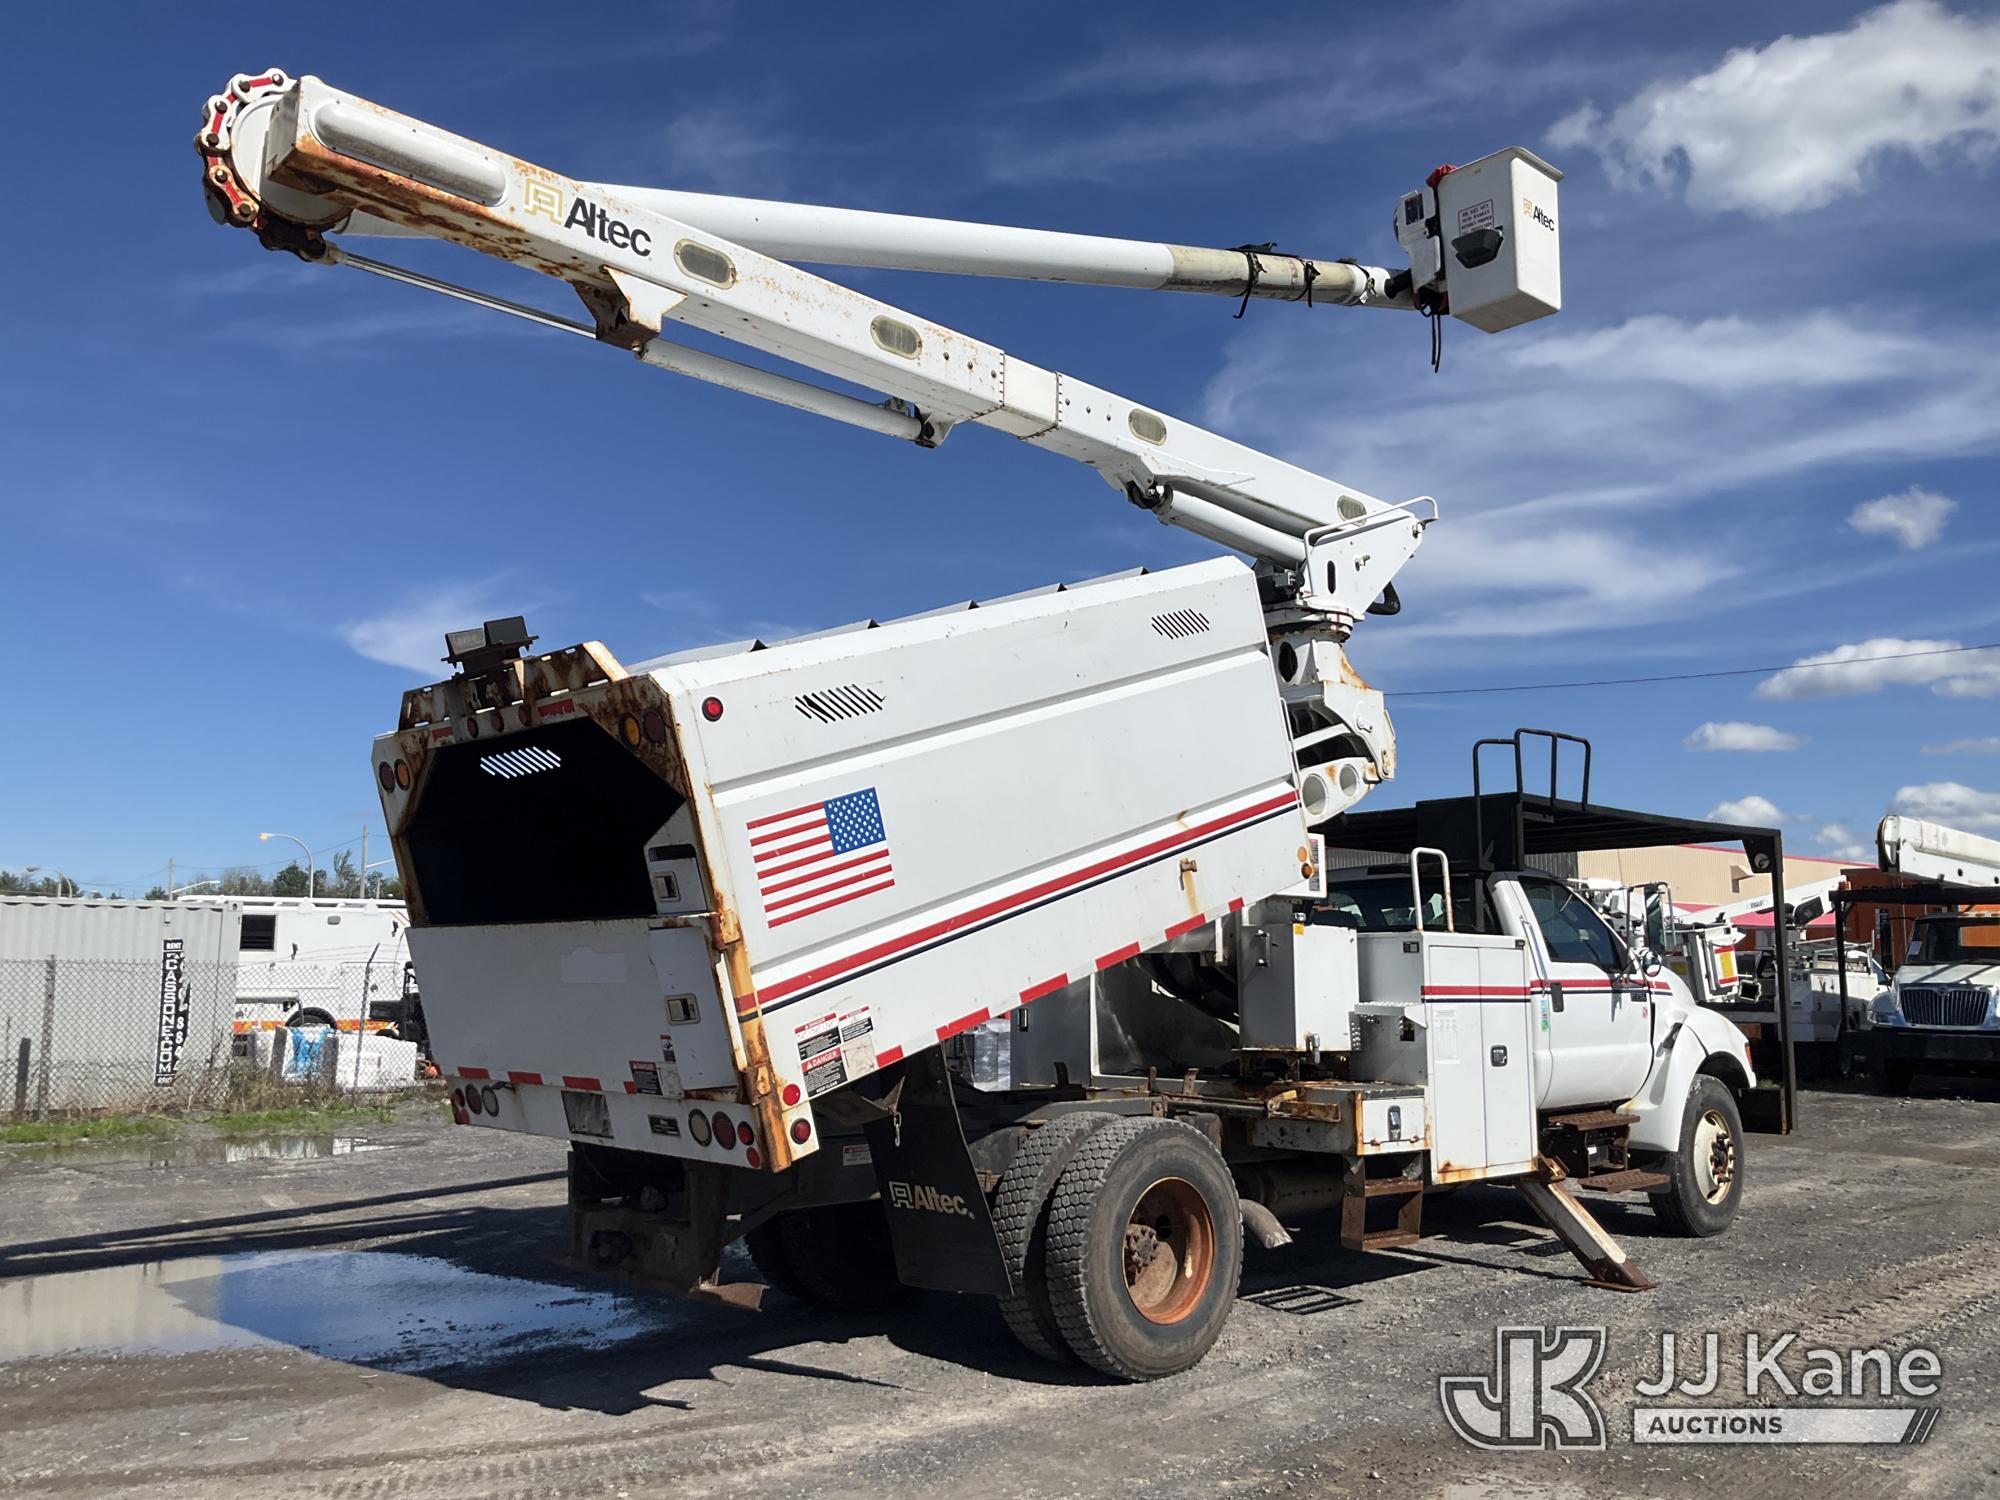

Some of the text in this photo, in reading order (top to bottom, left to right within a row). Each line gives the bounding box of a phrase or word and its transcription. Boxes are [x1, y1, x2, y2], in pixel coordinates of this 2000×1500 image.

[564, 197, 652, 257] Altec
[1533, 205, 1555, 232] Altec
[159, 959, 178, 1073] CASSONE.COM
[812, 1050, 838, 1067] DANGER
[914, 1184, 968, 1216] Altec
